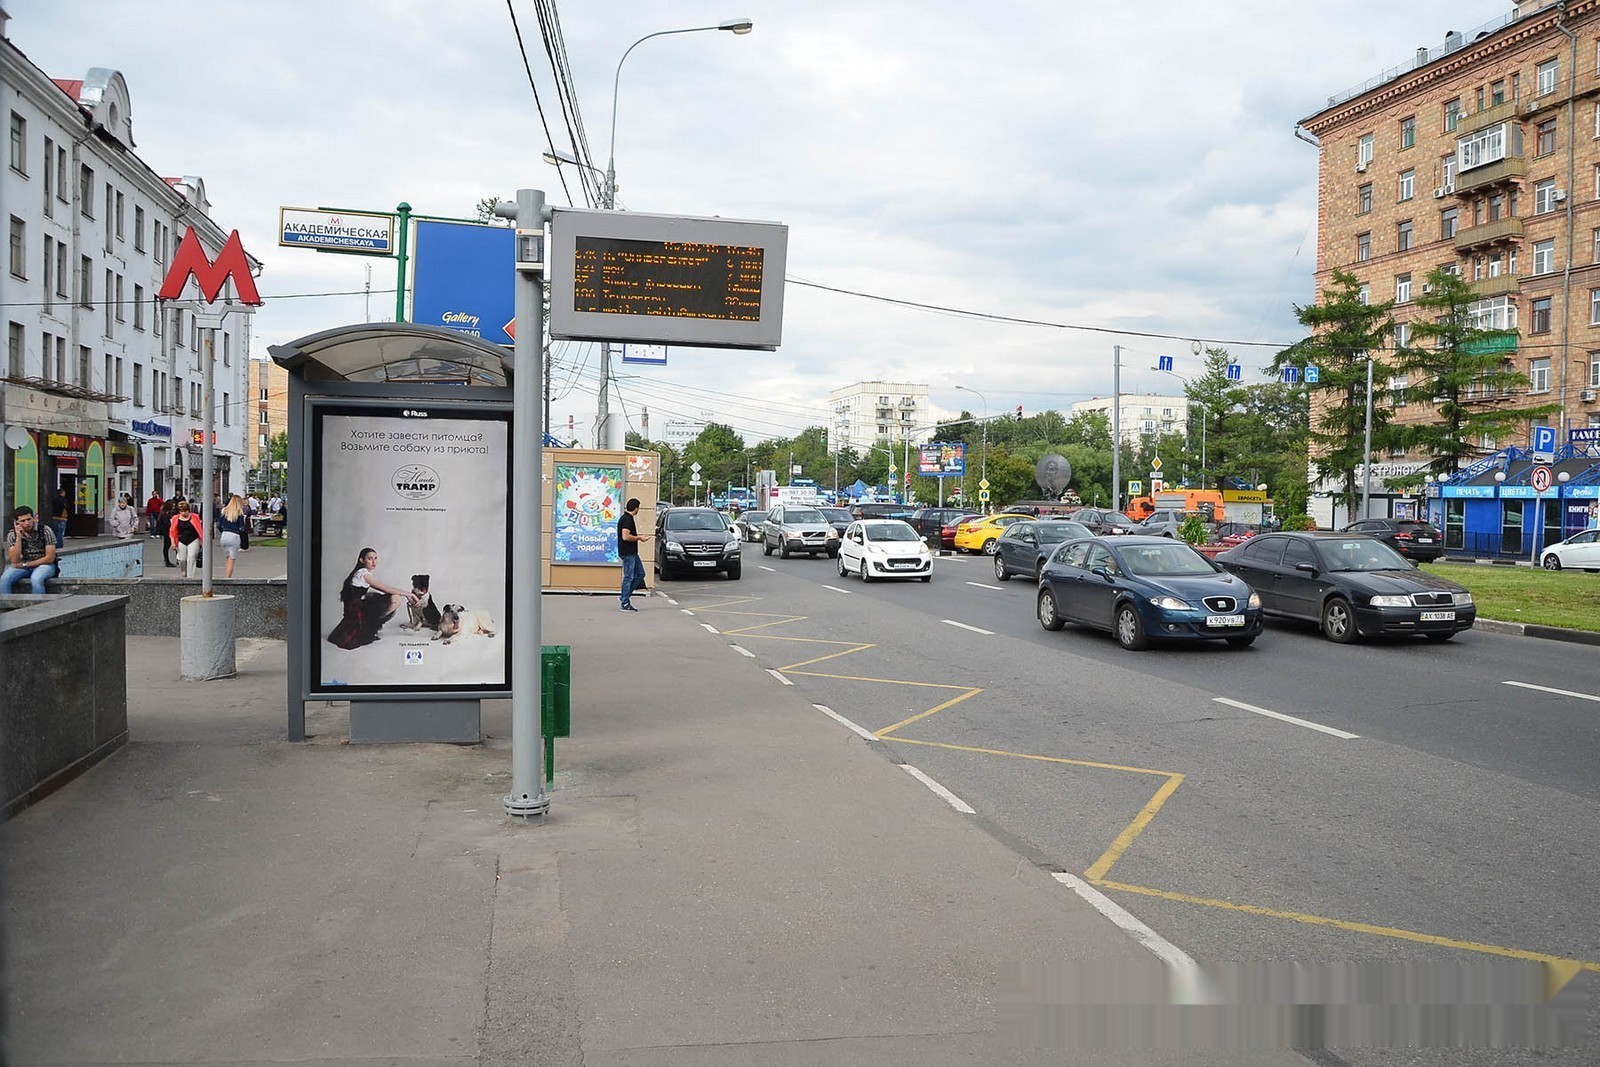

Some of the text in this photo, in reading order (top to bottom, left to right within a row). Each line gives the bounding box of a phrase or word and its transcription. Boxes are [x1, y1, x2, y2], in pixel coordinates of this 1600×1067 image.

[284, 222, 388, 238] АКАДЕМИЧЕСКАЯ
[298, 234, 374, 247] AKADEMICHESKAYA
[442, 312, 480, 328] Gallery
[350, 430, 484, 442] Хотите завести питомца?
[1540, 430, 1551, 449] P
[340, 442, 390, 452] Возьмите
[392, 443, 431, 454] собаку
[447, 446, 490, 454] приюта!
[397, 469, 435, 483] Haute
[1502, 489, 1526, 497] ЦВЕТЫ
[568, 511, 612, 525] 2014
[577, 544, 605, 552] годом!
